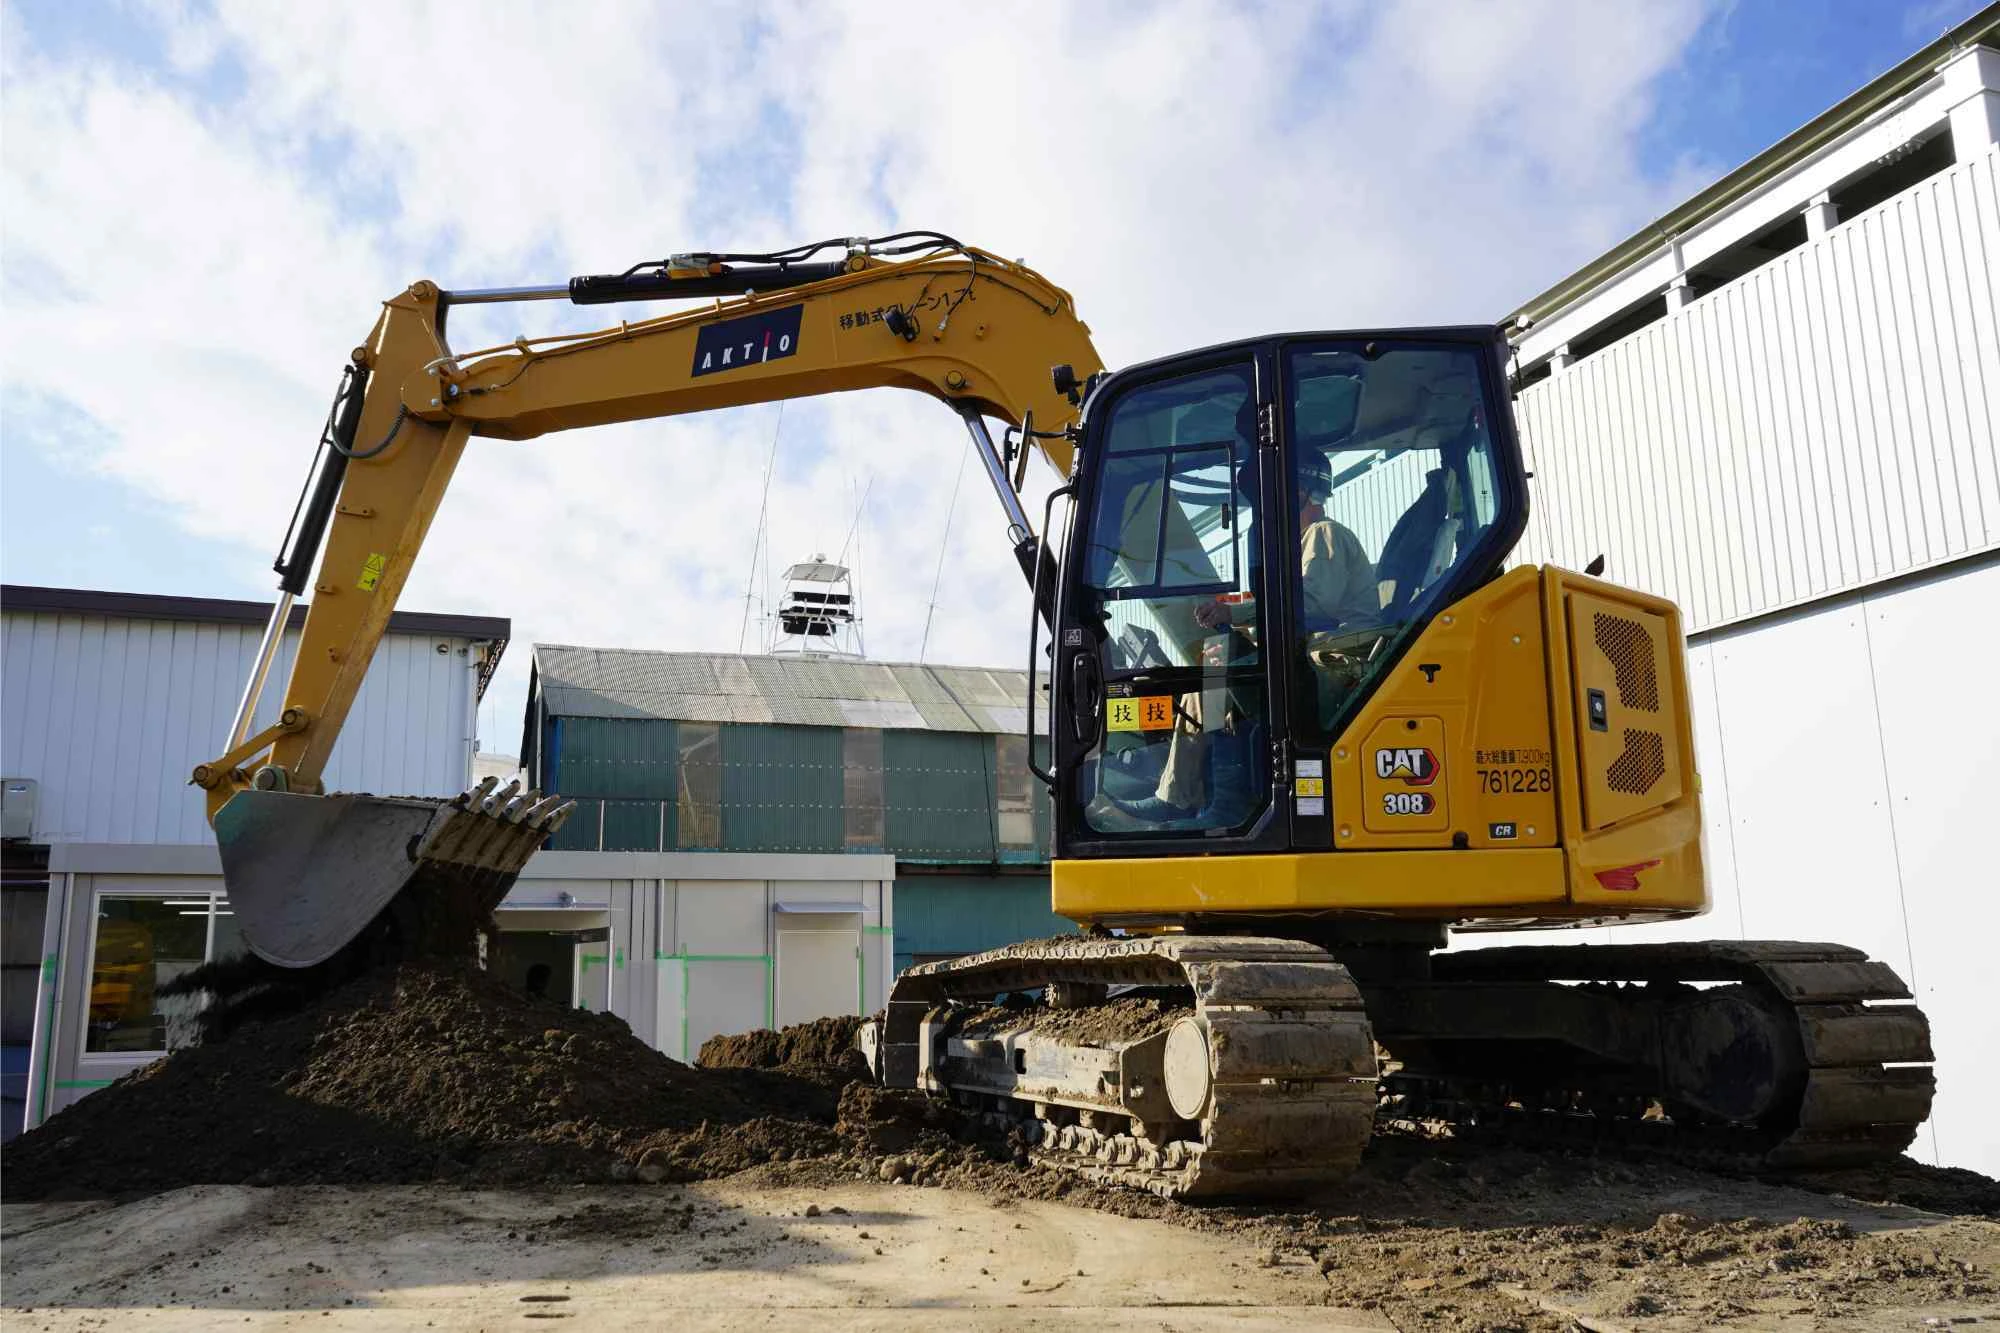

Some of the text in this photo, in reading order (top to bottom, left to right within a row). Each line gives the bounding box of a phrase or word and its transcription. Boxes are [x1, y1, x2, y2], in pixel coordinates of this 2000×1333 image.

[702, 331, 790, 369] AKTIO
[1114, 704, 1133, 723] 技
[1147, 702, 1165, 722] 技
[1376, 749, 1424, 778] CAT
[1476, 768, 1552, 794] 761228
[1384, 793, 1424, 814] 308
[1495, 825, 1512, 836] CR
